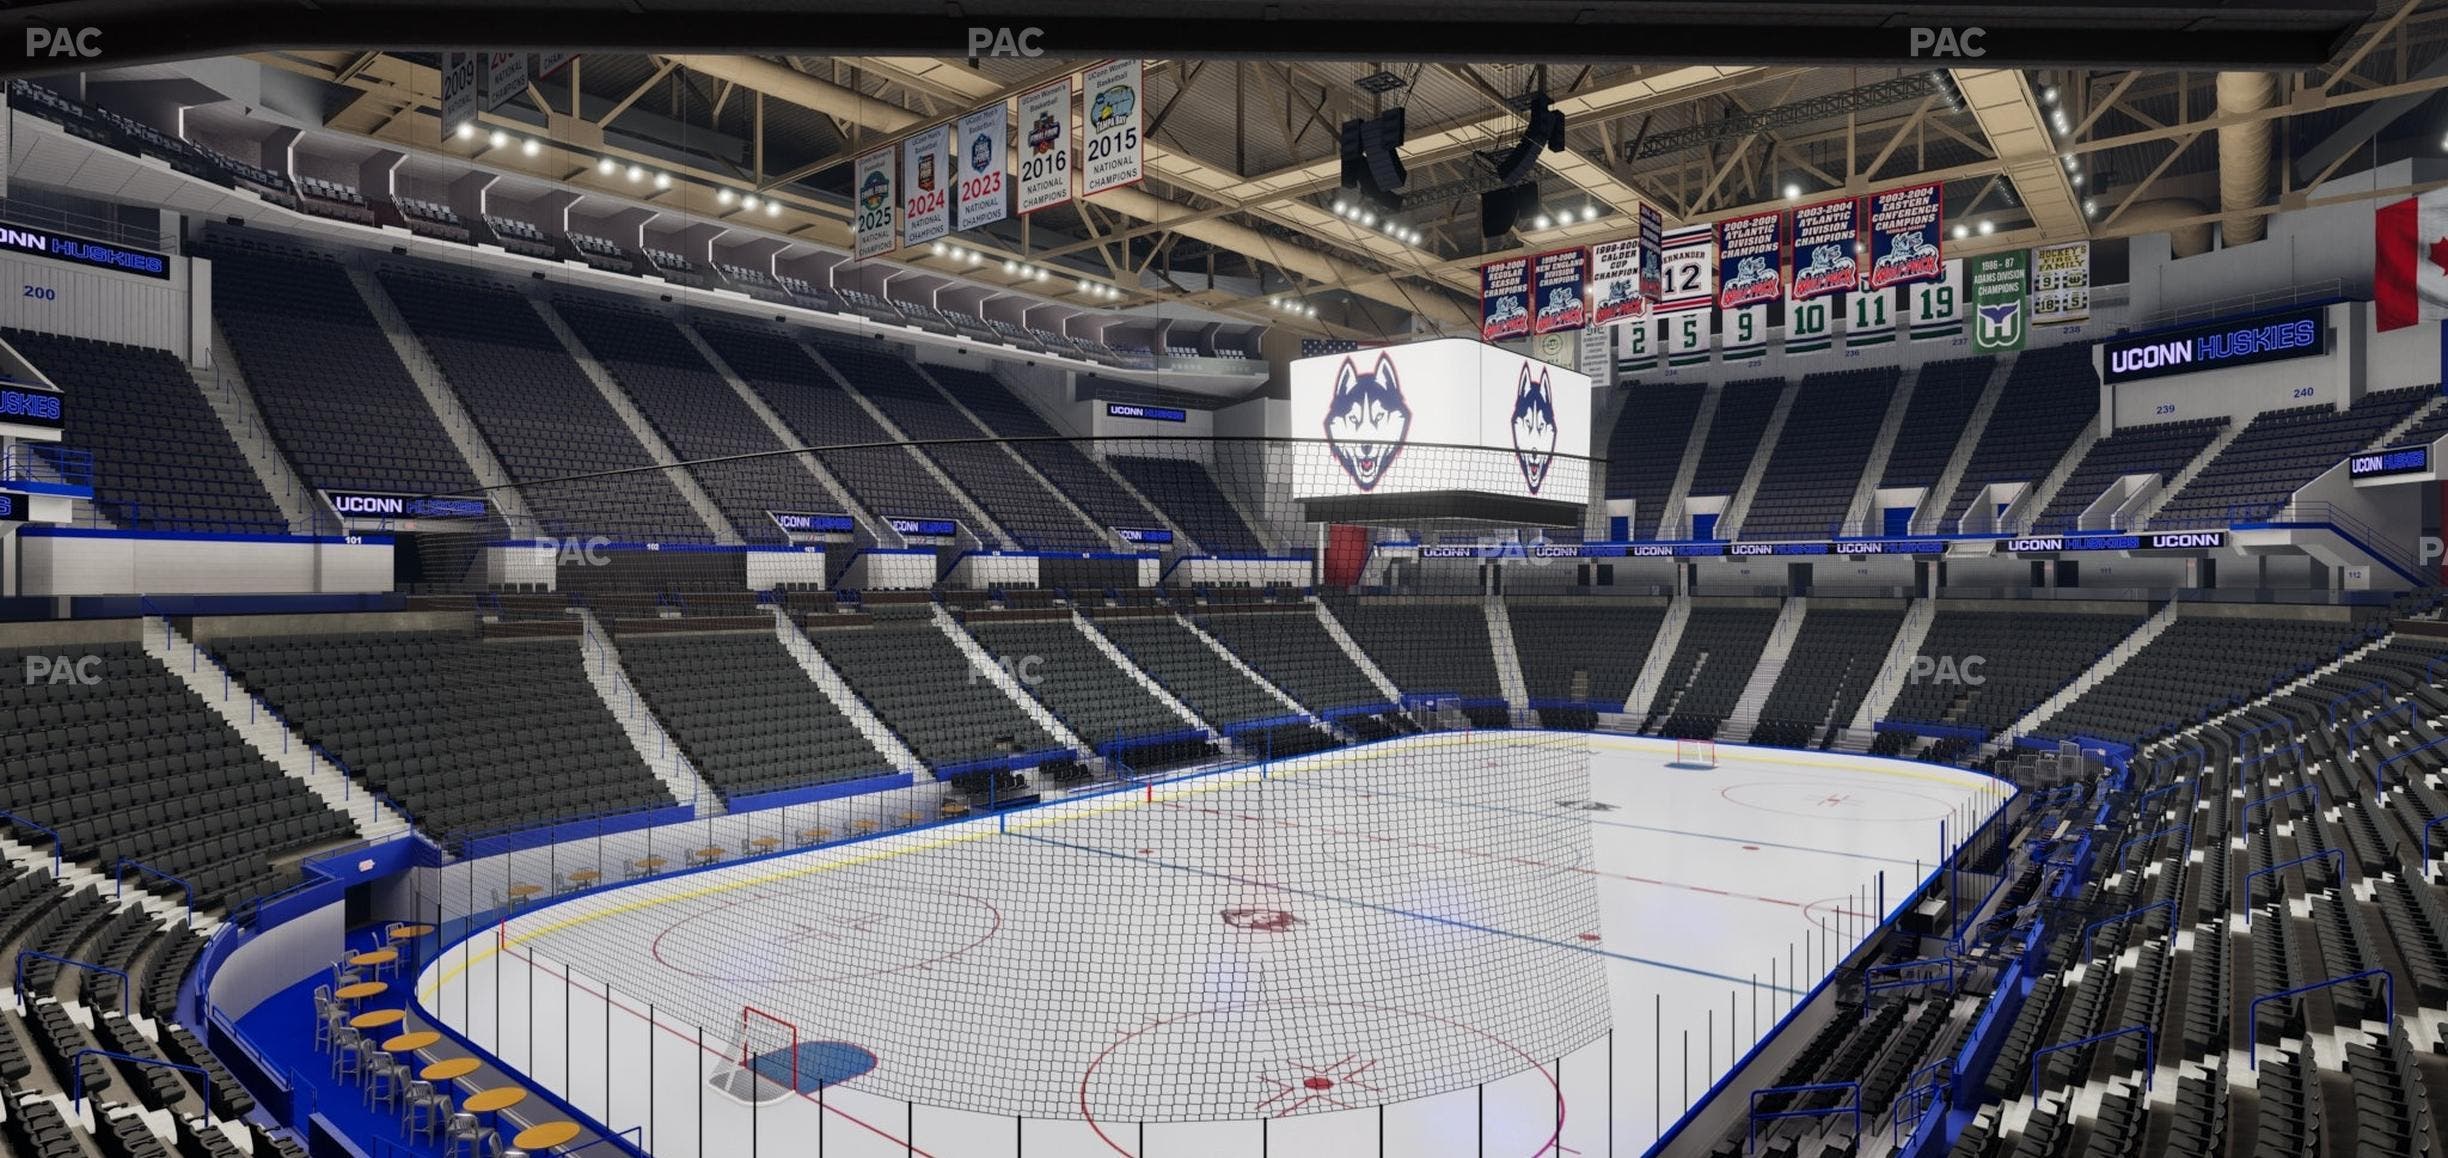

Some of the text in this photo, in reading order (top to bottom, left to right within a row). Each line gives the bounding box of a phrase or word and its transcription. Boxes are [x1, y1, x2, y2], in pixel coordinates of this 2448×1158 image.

[444, 59, 474, 101] 2009
[1088, 126, 1137, 162] 2015
[1022, 149, 1066, 183] 2016
[1093, 155, 1134, 174] NATIONAL
[961, 170, 1001, 202] 2023
[1027, 177, 1063, 194] NATIONAL
[1089, 167, 1138, 190] CHAMPIONS
[908, 188, 945, 219] 2024
[1022, 189, 1067, 209] CHAMPIONS
[1878, 187, 1934, 204] 2003-2004
[964, 197, 998, 214] NATIONAL
[1797, 201, 1853, 219] 2003-2004
[1882, 196, 1930, 212] EASTERN
[858, 206, 891, 233] 2025
[962, 209, 1002, 228] CHAMPIONS
[1798, 211, 1851, 228] ATLANTIC
[1872, 203, 1939, 223] CONFERENCE
[911, 215, 942, 230] NATIONAL
[1724, 215, 1778, 232] 2008-2009
[1801, 221, 1848, 237] DIVISION
[1875, 213, 1936, 231] CHAMPIONS
[862, 230, 890, 243] NATIONAL
[908, 224, 944, 242] CHAMPIONS
[1725, 224, 1775, 241] ATLANTIC
[1794, 229, 1855, 248] CHAMPIONS
[859, 240, 892, 257] CHAMPIONS
[1596, 240, 1641, 255] 1999-200
[1727, 234, 1772, 249] DIVISION
[52, 238, 163, 273] HUSKIES
[1601, 249, 1637, 262] CALDER
[1662, 251, 1706, 264] ERNANDER
[1721, 242, 1779, 260] CHAMPIONS
[2038, 244, 2087, 260] HOCKEY'S
[1487, 259, 1526, 273] 1999-2000
[1535, 258, 1585, 273] NEW ENGLAND
[1610, 260, 1628, 270] CUP
[2004, 257, 2015, 268] 87
[2038, 259, 2085, 272] FAMILY
[1488, 268, 1523, 281] REGULAR
[1539, 273, 1580, 287] CHAMPIONS
[1544, 267, 1575, 280] DIVISION
[1663, 261, 1702, 295] 12
[1974, 268, 2025, 284] ADAMS DIVISION
[1484, 283, 1528, 298] CHAMPIONS
[1490, 277, 1521, 289] SEASON
[1978, 281, 2020, 296] CHAMPIONS
[23, 285, 56, 300] 200
[1856, 294, 1886, 328] 11
[1920, 286, 1953, 320] 19
[2040, 299, 2054, 311] 18
[1738, 312, 1752, 342] 9
[1795, 304, 1825, 335] 10
[1632, 327, 1645, 354] 2
[1683, 319, 1697, 348] 5
[2111, 319, 2315, 373] UCONN HUSKIES
[2293, 386, 2315, 398] 240
[1110, 405, 1144, 417] UCONN
[2155, 403, 2175, 415] 239
[2351, 455, 2383, 474] UCONN
[336, 496, 403, 513] UCONN
[345, 536, 362, 544] 101
[1836, 542, 1882, 554] UCONN
[2008, 539, 2063, 551] UCONN
[2153, 533, 2220, 547] UCONN
[1423, 547, 1470, 557] UCONN
[1536, 547, 1578, 556] UCONN
[1634, 545, 1673, 556] UCONN
[1731, 544, 1772, 555] UCONN
[2348, 571, 2361, 579] 112
